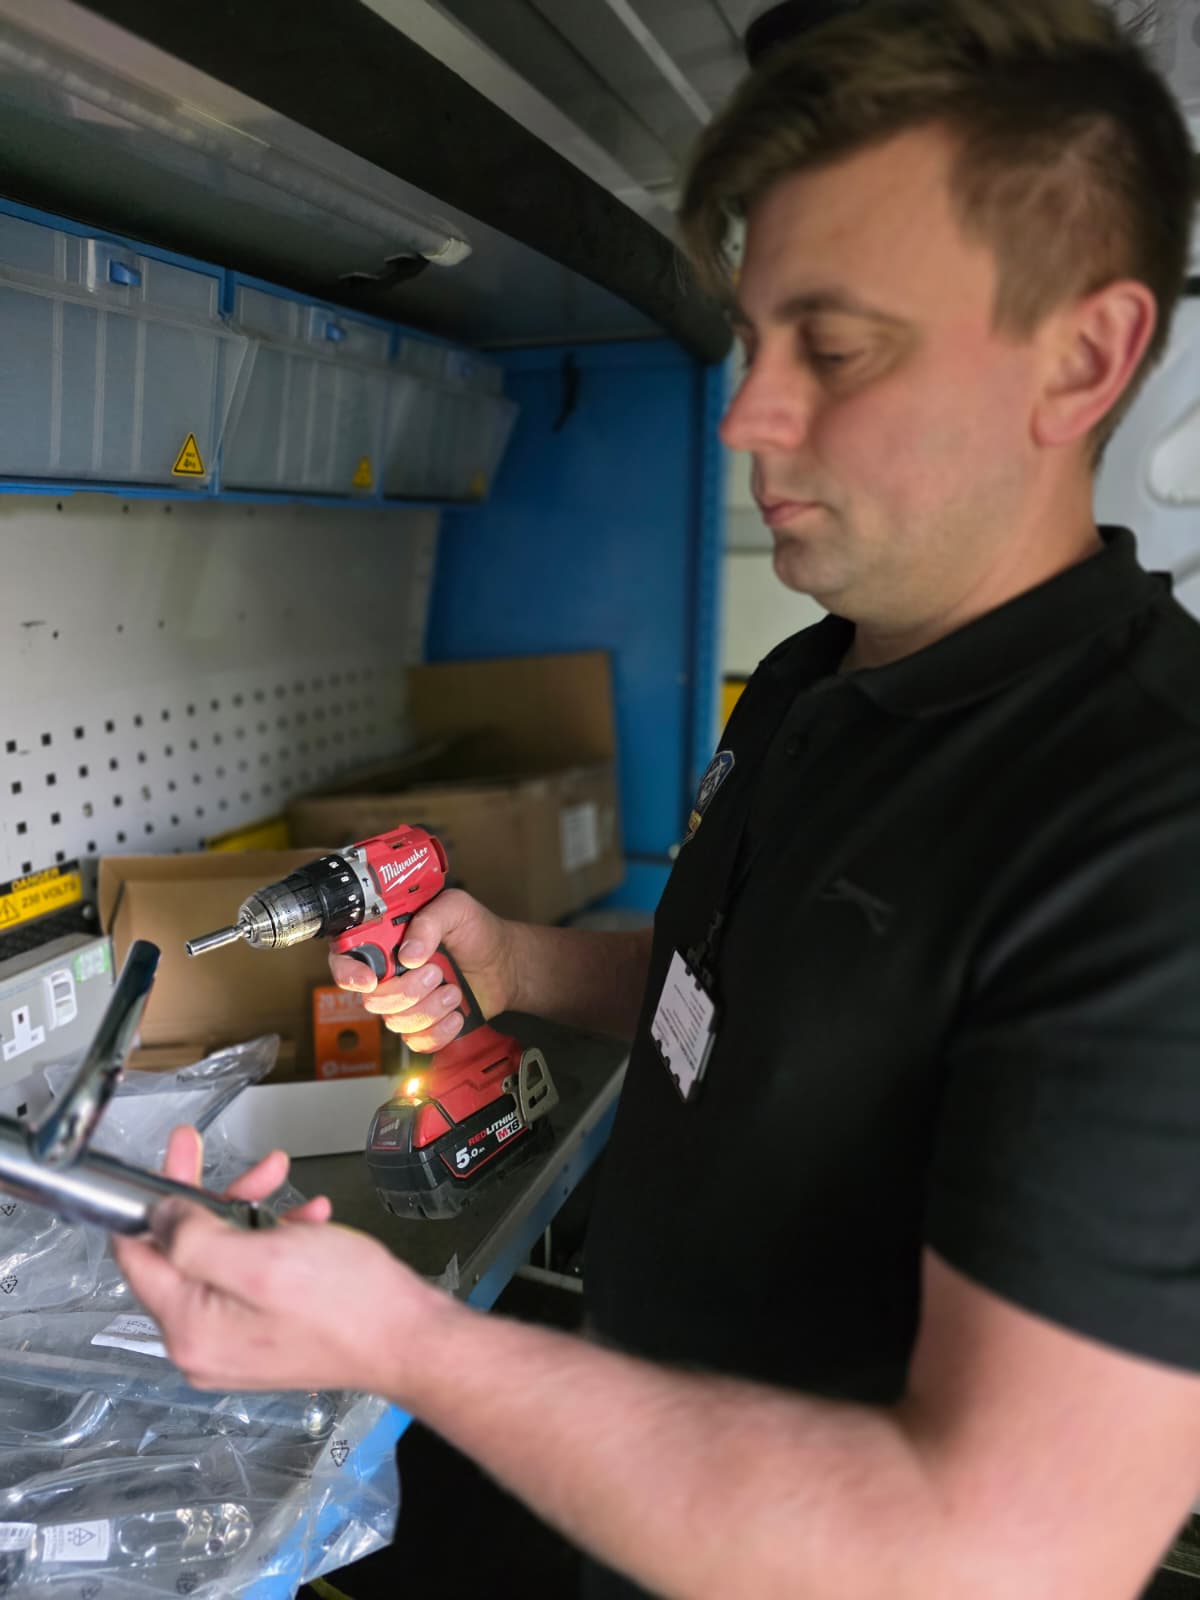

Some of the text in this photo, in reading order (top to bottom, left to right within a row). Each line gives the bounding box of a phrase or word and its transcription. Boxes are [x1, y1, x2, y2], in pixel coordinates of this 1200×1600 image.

[378, 847, 428, 885] Milwaukee
[467, 1111, 516, 1147] REDLITHIU
[497, 1120, 521, 1141] M18
